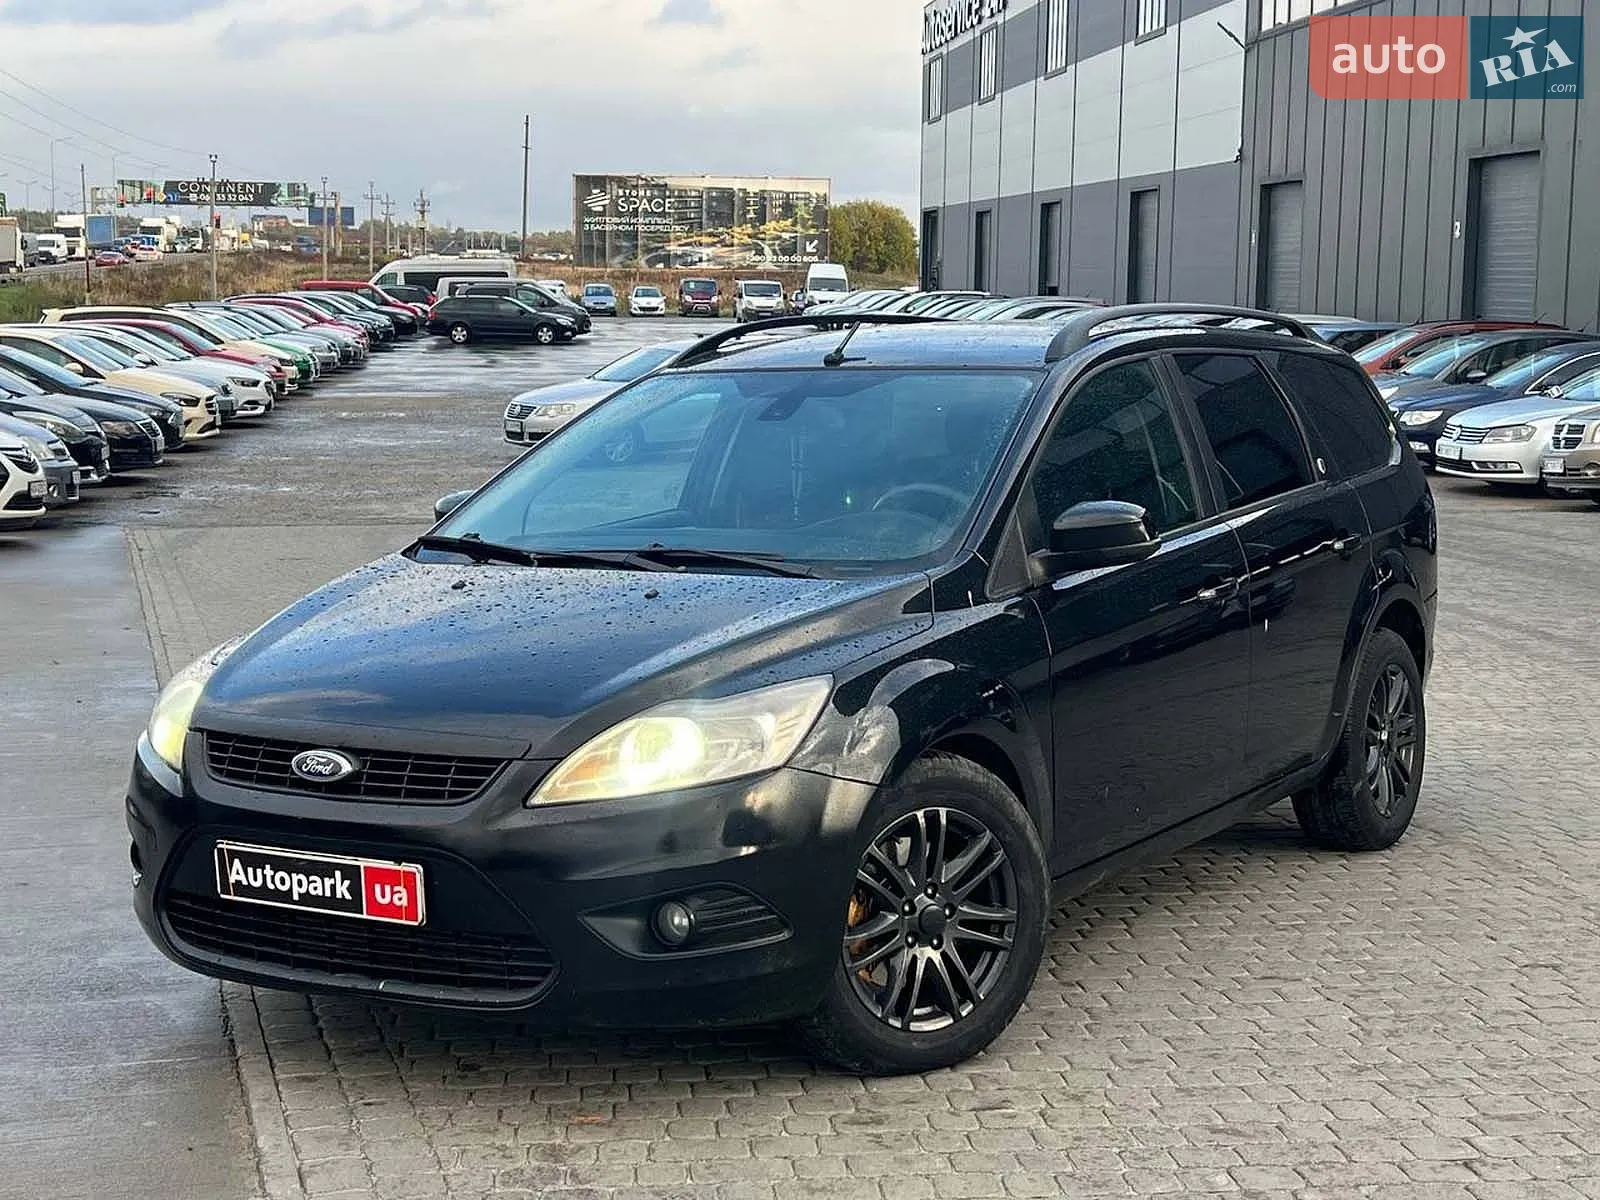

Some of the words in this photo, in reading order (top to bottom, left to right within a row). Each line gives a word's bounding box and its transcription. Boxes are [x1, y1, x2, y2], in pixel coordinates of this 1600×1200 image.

[617, 198, 675, 213] SPACE
[301, 757, 335, 775] Ford
[230, 858, 352, 901] Autopark
[374, 883, 409, 908] ua
